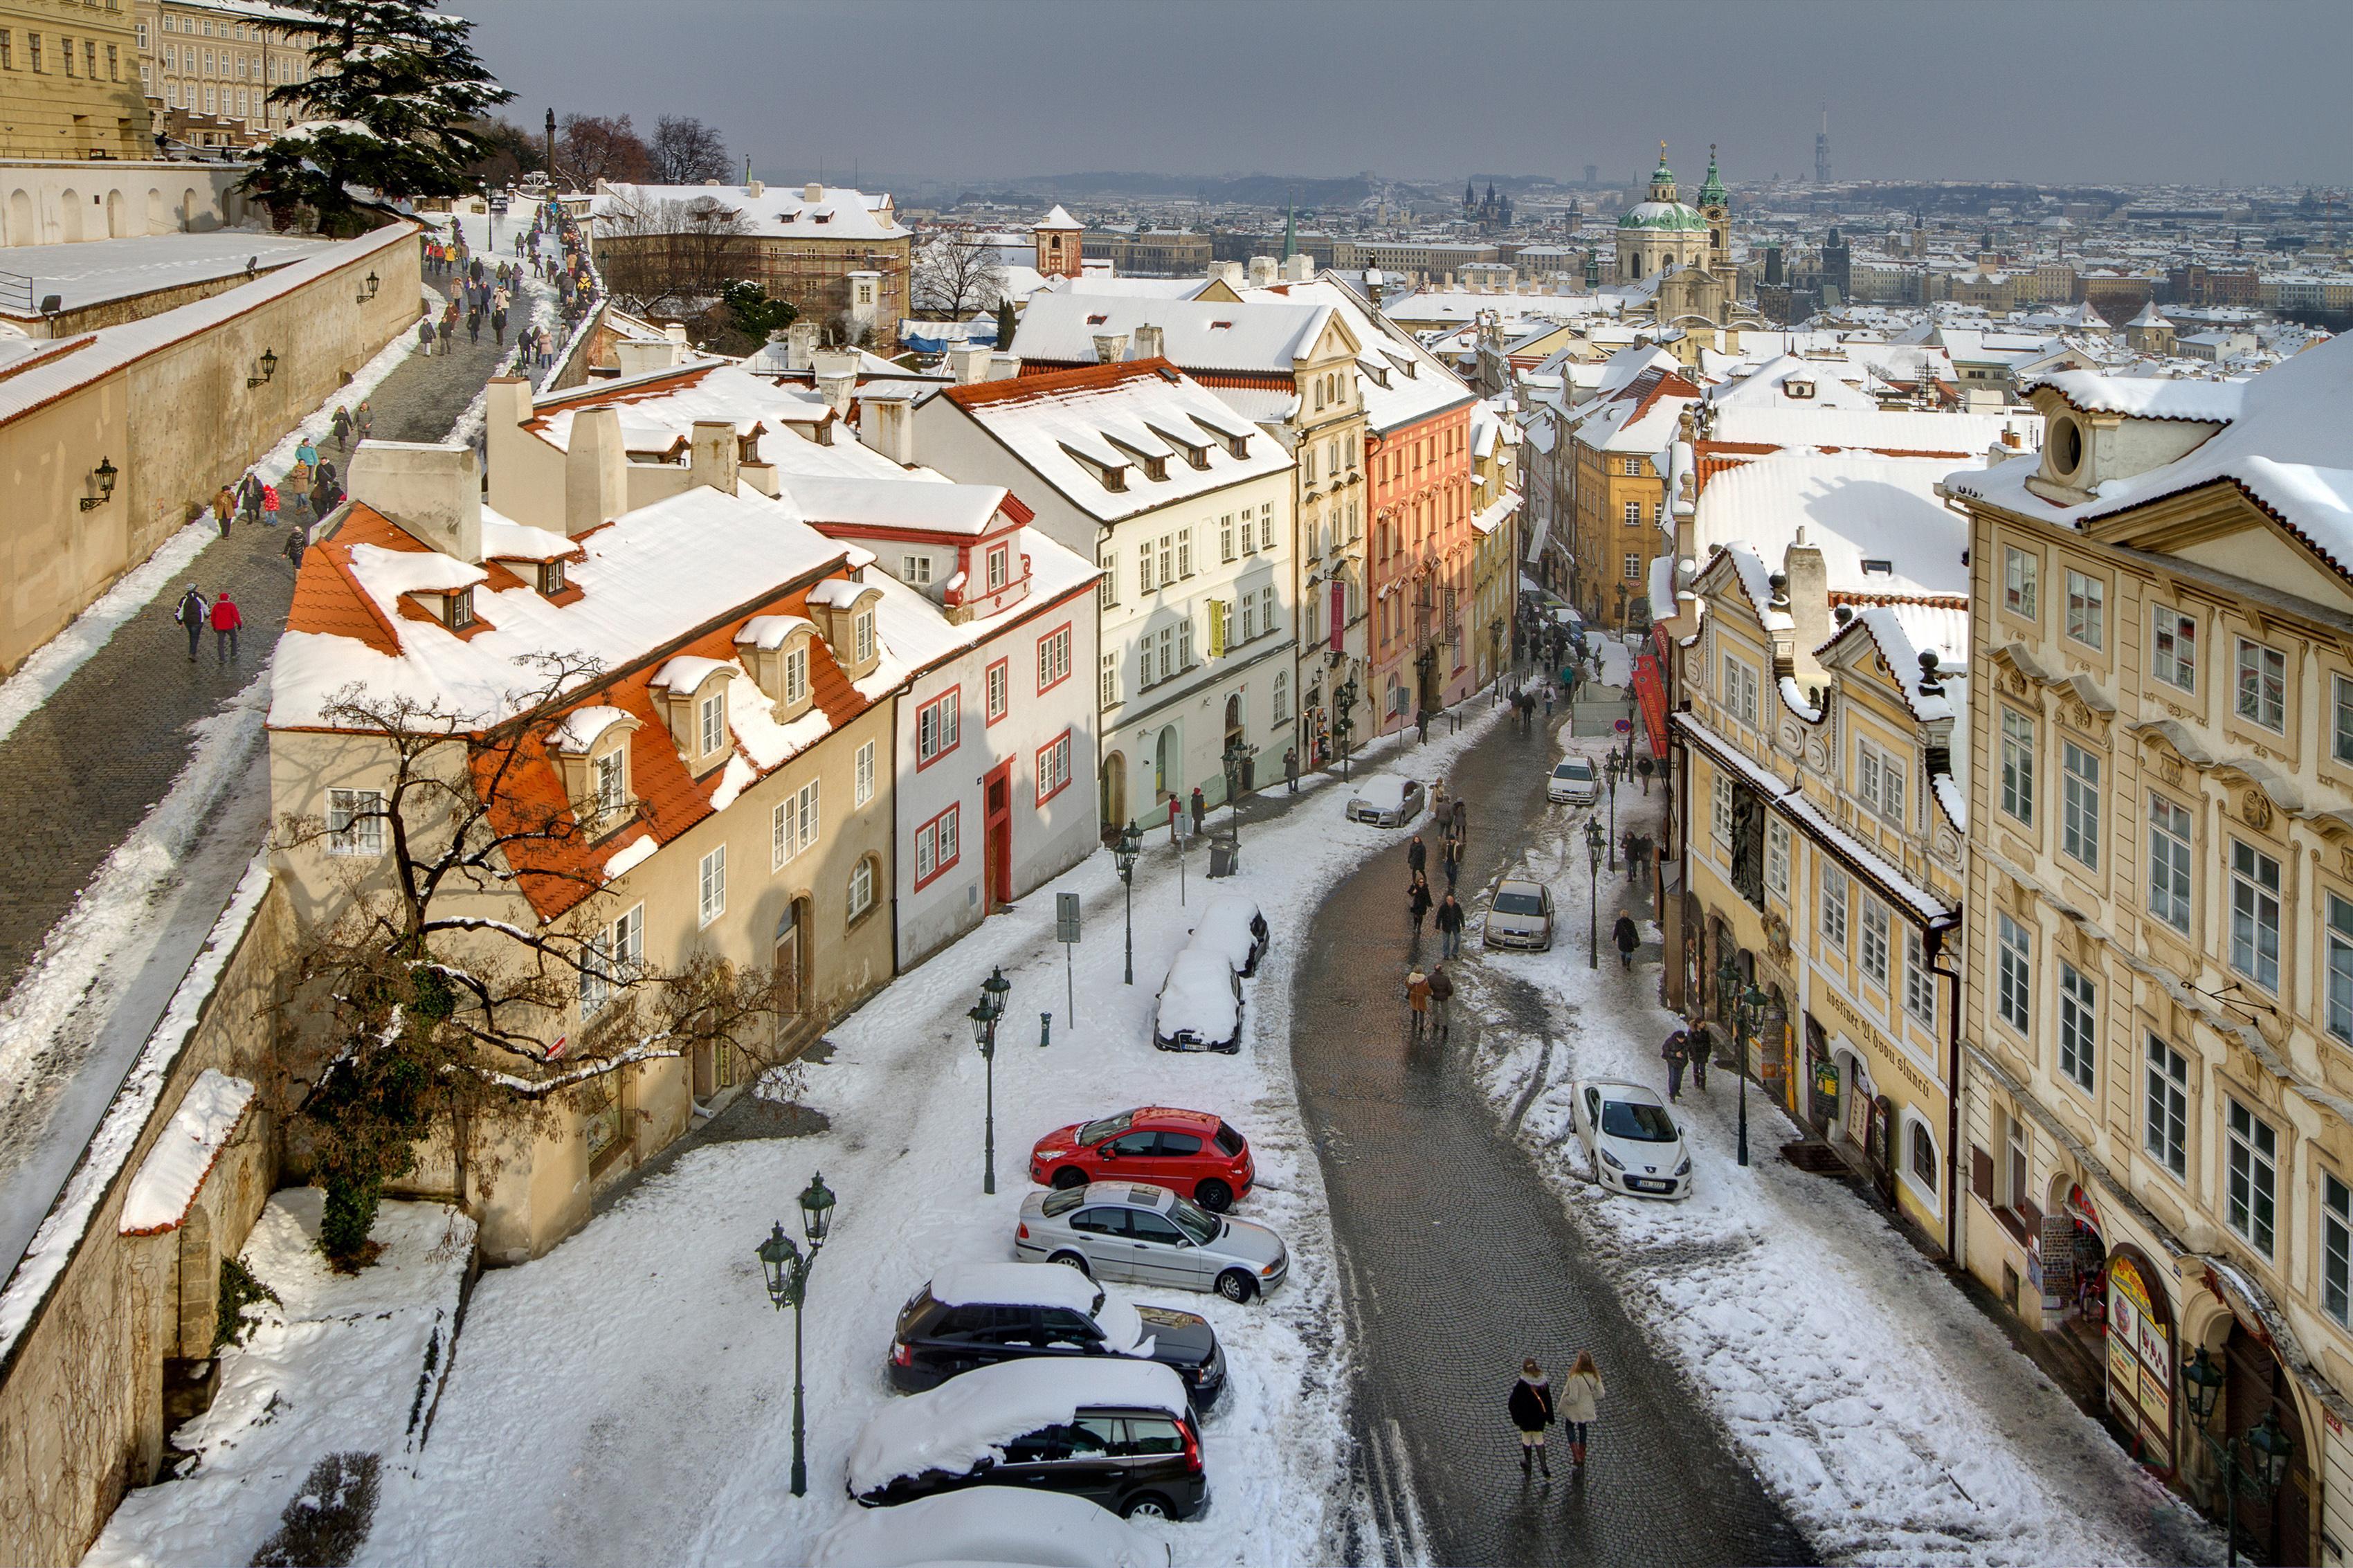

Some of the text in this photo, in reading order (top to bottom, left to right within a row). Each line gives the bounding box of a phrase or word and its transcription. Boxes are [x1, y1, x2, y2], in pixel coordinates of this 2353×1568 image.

[1421, 623, 1430, 650] garden
[1826, 987, 1859, 1030] hostinec
[1873, 1030, 1896, 1066] dvou
[1897, 1057, 1930, 1100] slunců
